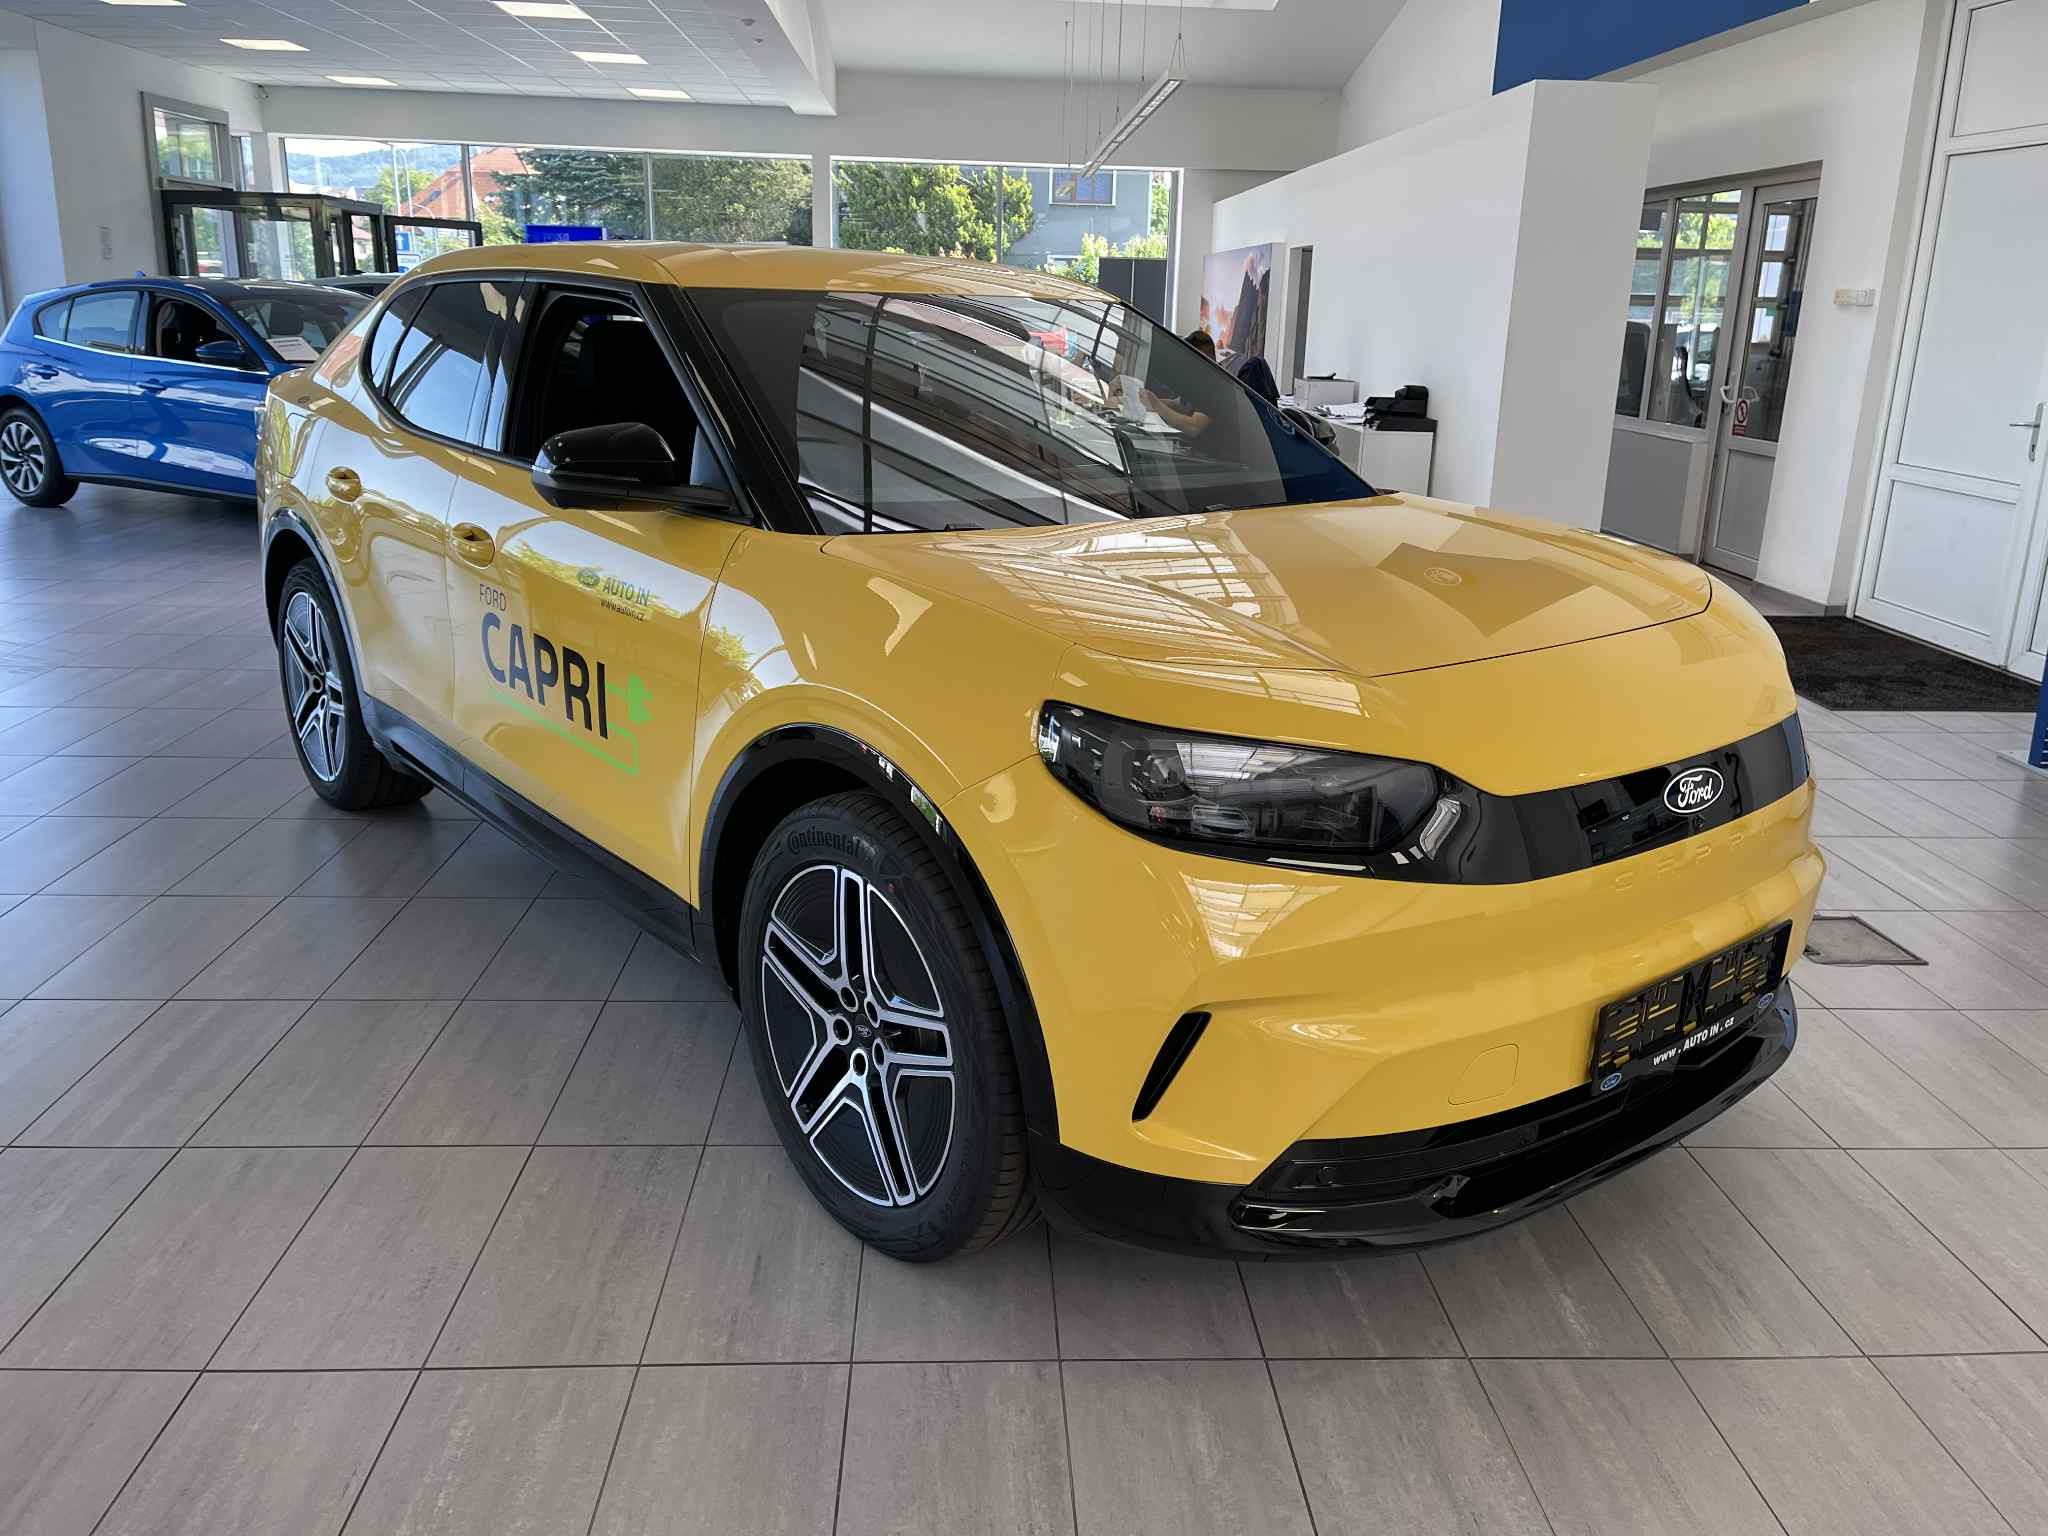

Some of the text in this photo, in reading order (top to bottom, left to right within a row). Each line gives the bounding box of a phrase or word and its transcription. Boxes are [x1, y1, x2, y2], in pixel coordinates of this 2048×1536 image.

[479, 583, 507, 612] FORD
[603, 576, 650, 607] AUTO IN
[481, 612, 609, 740] CAPRI
[1677, 774, 1714, 808] Ford
[786, 825, 862, 858] Continental
[1683, 1030, 1709, 1051] AUTO
